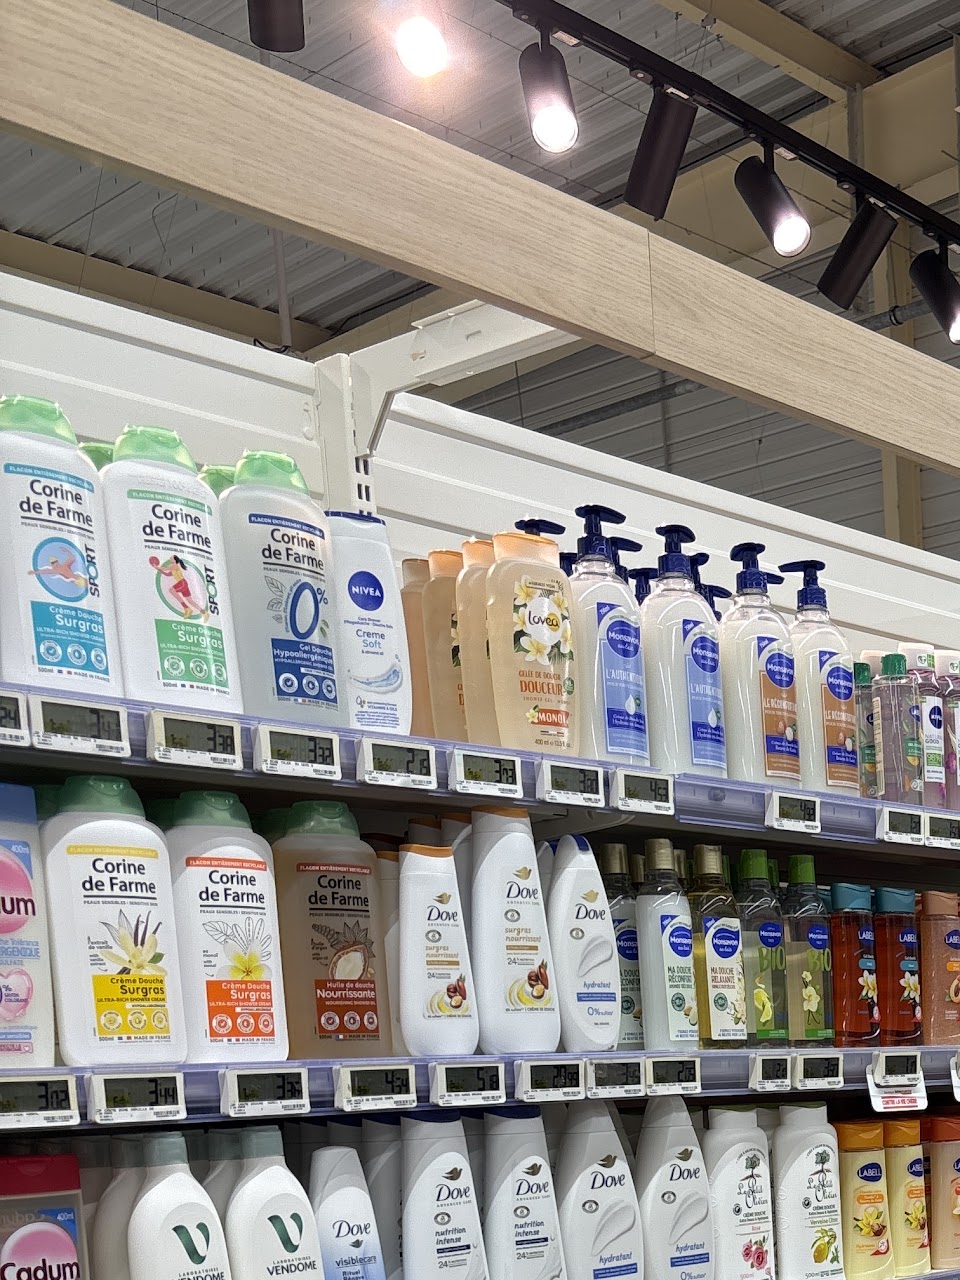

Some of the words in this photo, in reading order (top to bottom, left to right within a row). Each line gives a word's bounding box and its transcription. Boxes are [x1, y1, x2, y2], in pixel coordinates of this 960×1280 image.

[29, 479, 83, 505] Corine
[19, 498, 43, 513] de
[47, 500, 93, 527] Farme
[151, 503, 202, 528] Corine
[142, 520, 165, 537] de
[169, 524, 212, 548] Farme
[270, 528, 316, 551] Corine
[262, 544, 282, 559] de
[286, 548, 324, 571] Farme
[85, 544, 100, 597] SPORT
[203, 564, 219, 616] SPORT
[351, 585, 382, 597] NIVEA
[49, 605, 75, 616] Crème
[77, 607, 103, 621] Douche
[528, 611, 559, 630] lovea
[55, 614, 104, 634] Surgras
[178, 631, 223, 648] Surgras
[355, 629, 386, 640] Creme
[609, 631, 639, 645] Monsavon
[362, 639, 382, 649] Soft
[767, 664, 794, 675] Monsavon
[520, 680, 562, 696] DOUCEUR
[828, 676, 853, 688] Monsavon
[92, 858, 146, 875] Corine
[82, 876, 105, 892] de
[110, 877, 156, 894] Farme
[208, 870, 256, 886] Corine
[317, 875, 361, 890] Corine
[199, 888, 219, 902] de
[224, 888, 265, 904] Farme
[506, 881, 538, 899] Dove
[308, 892, 327, 906] de
[331, 892, 369, 907] Farme
[427, 905, 458, 921] Dove
[575, 904, 606, 920] Dove
[505, 927, 531, 936] surgras
[760, 930, 781, 938] Monsavon
[713, 936, 738, 946] Monsavon
[719, 967, 734, 975] DOUCHE
[110, 977, 136, 985] Crème
[139, 977, 164, 986] Douche
[221, 982, 244, 990] Crème
[583, 981, 610, 990] hydratant
[120, 985, 165, 998] Surgras
[230, 989, 271, 1003] Surgras
[317, 988, 375, 999] Nourrissante
[669, 1164, 700, 1181] Dove
[858, 1169, 881, 1178] LABELL
[516, 1179, 549, 1196] Dove
[591, 1171, 625, 1190] Dove
[436, 1184, 470, 1202] Dove
[57, 1212, 74, 1221] 400ml
[332, 1220, 371, 1238] Dove
[435, 1227, 466, 1237] nutrition
[514, 1220, 544, 1230] nutrition
[436, 1236, 461, 1245] intense
[515, 1229, 539, 1237] intense
[676, 1242, 705, 1252] hydratant
[273, 1256, 311, 1264] LABORATOIRES
[335, 1255, 376, 1267] visiblecare
[599, 1252, 632, 1265] hydratant
[178, 1267, 219, 1278] LABORATOIRES
[267, 1260, 317, 1277] VENDOME
